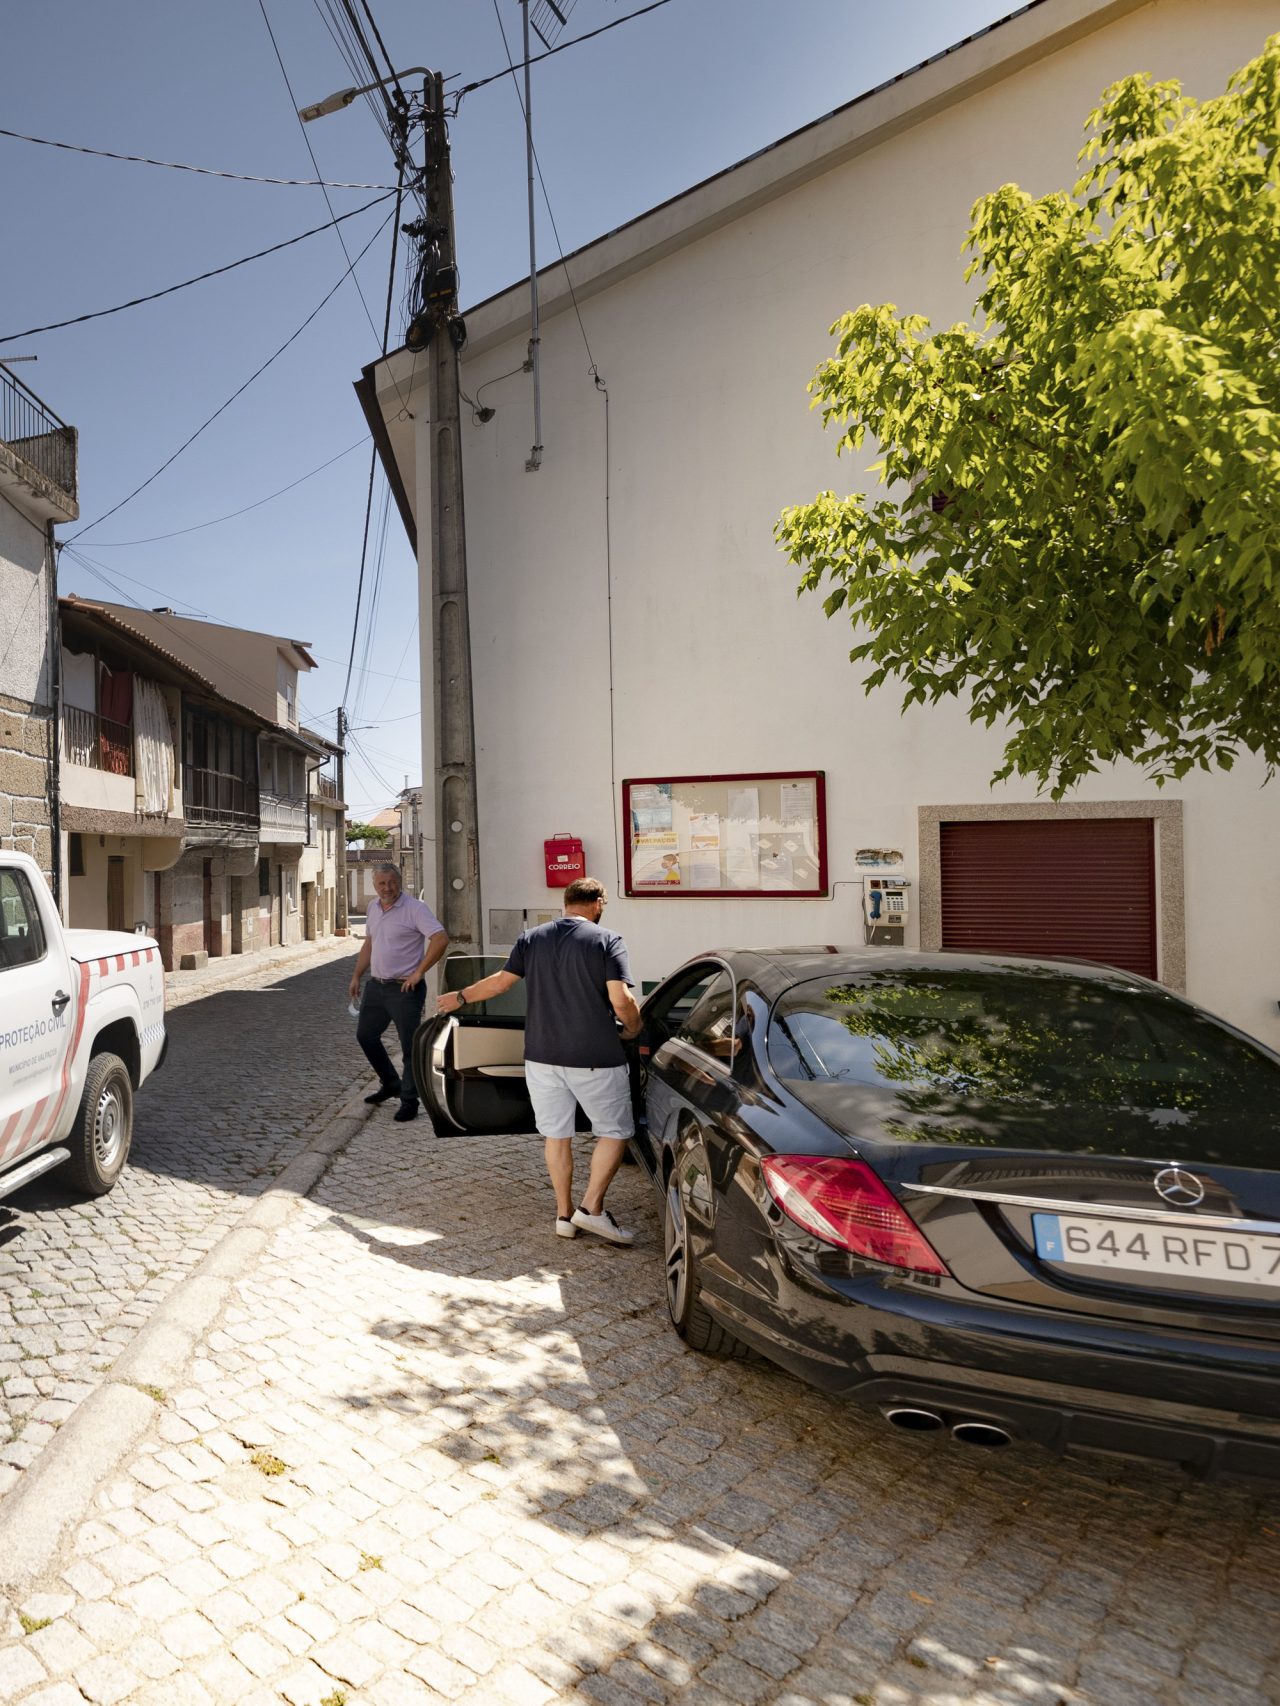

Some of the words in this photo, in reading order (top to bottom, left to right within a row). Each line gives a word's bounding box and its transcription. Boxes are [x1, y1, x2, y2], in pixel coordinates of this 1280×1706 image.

[548, 863, 581, 871] CORREIO
[47, 1014, 66, 1033] CIVIL
[1046, 1240, 1056, 1252] F
[1065, 1225, 1151, 1262] 644
[1161, 1235, 1251, 1272] RFD
